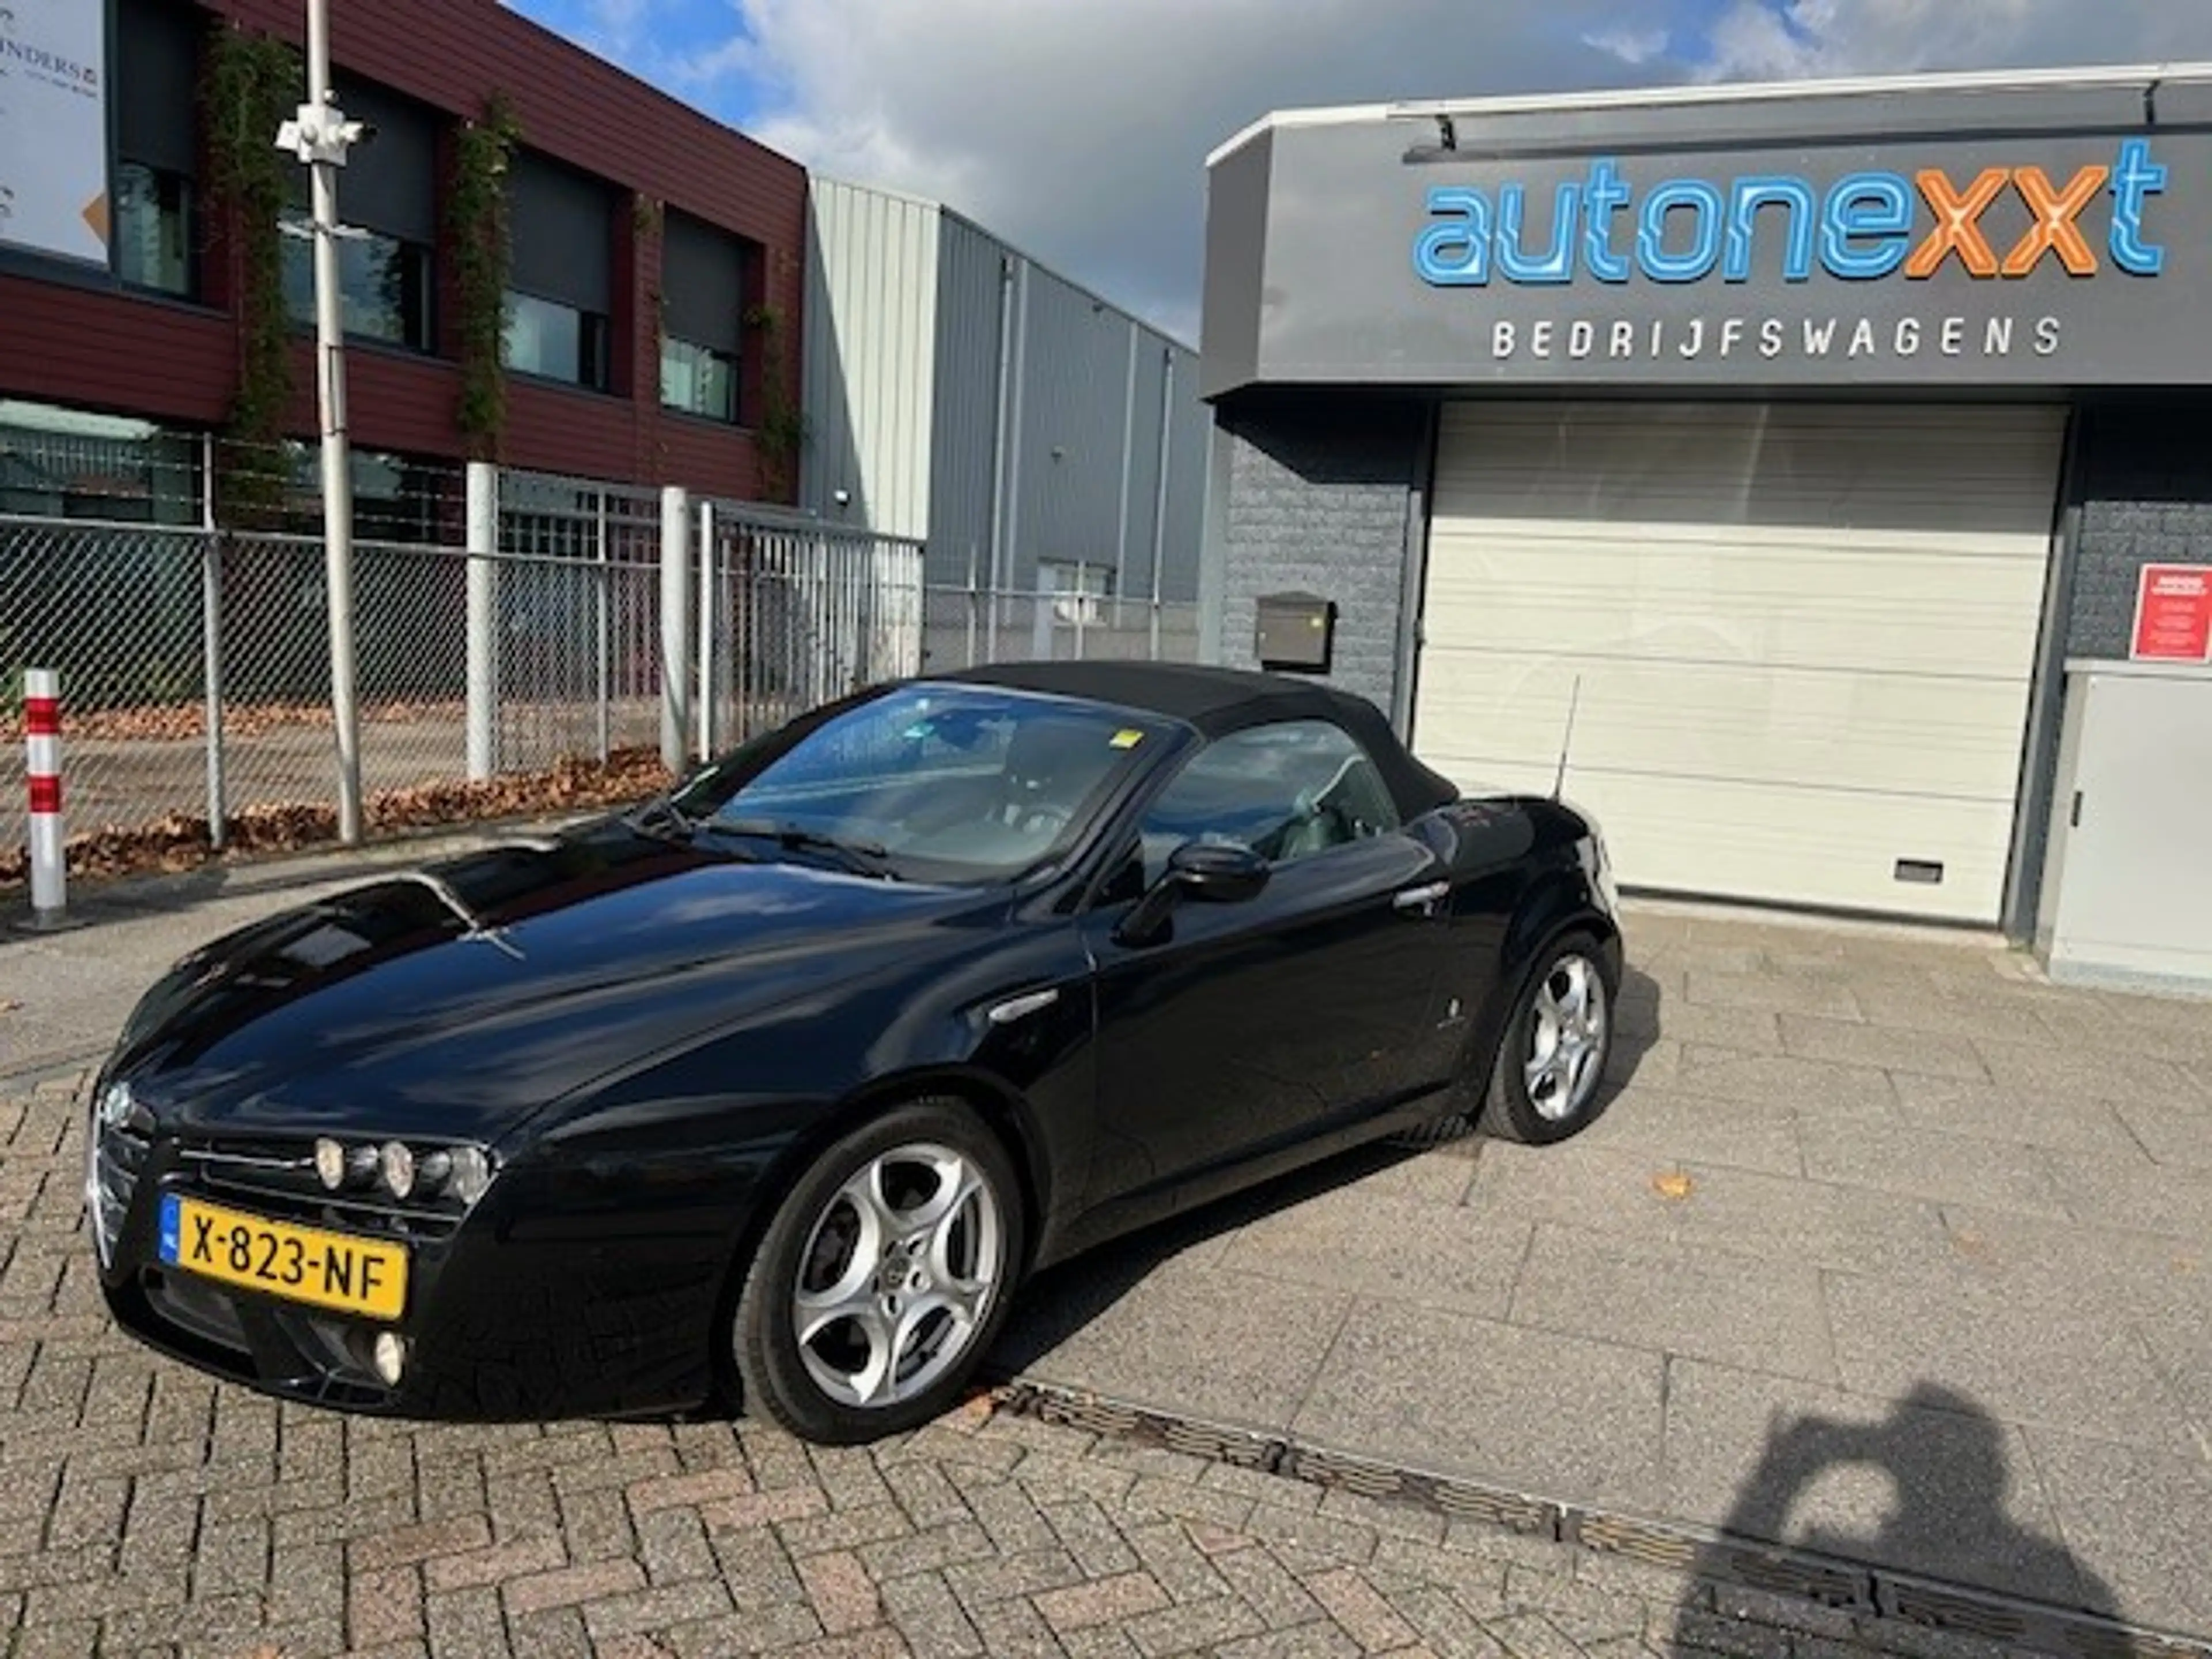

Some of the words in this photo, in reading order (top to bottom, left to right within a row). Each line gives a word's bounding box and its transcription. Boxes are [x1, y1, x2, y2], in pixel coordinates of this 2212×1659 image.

[1414, 138, 2167, 286] autonexxt
[1493, 317, 2062, 358] BEDRIJFSWAGENS
[193, 1214, 385, 1300] X-823-NF
